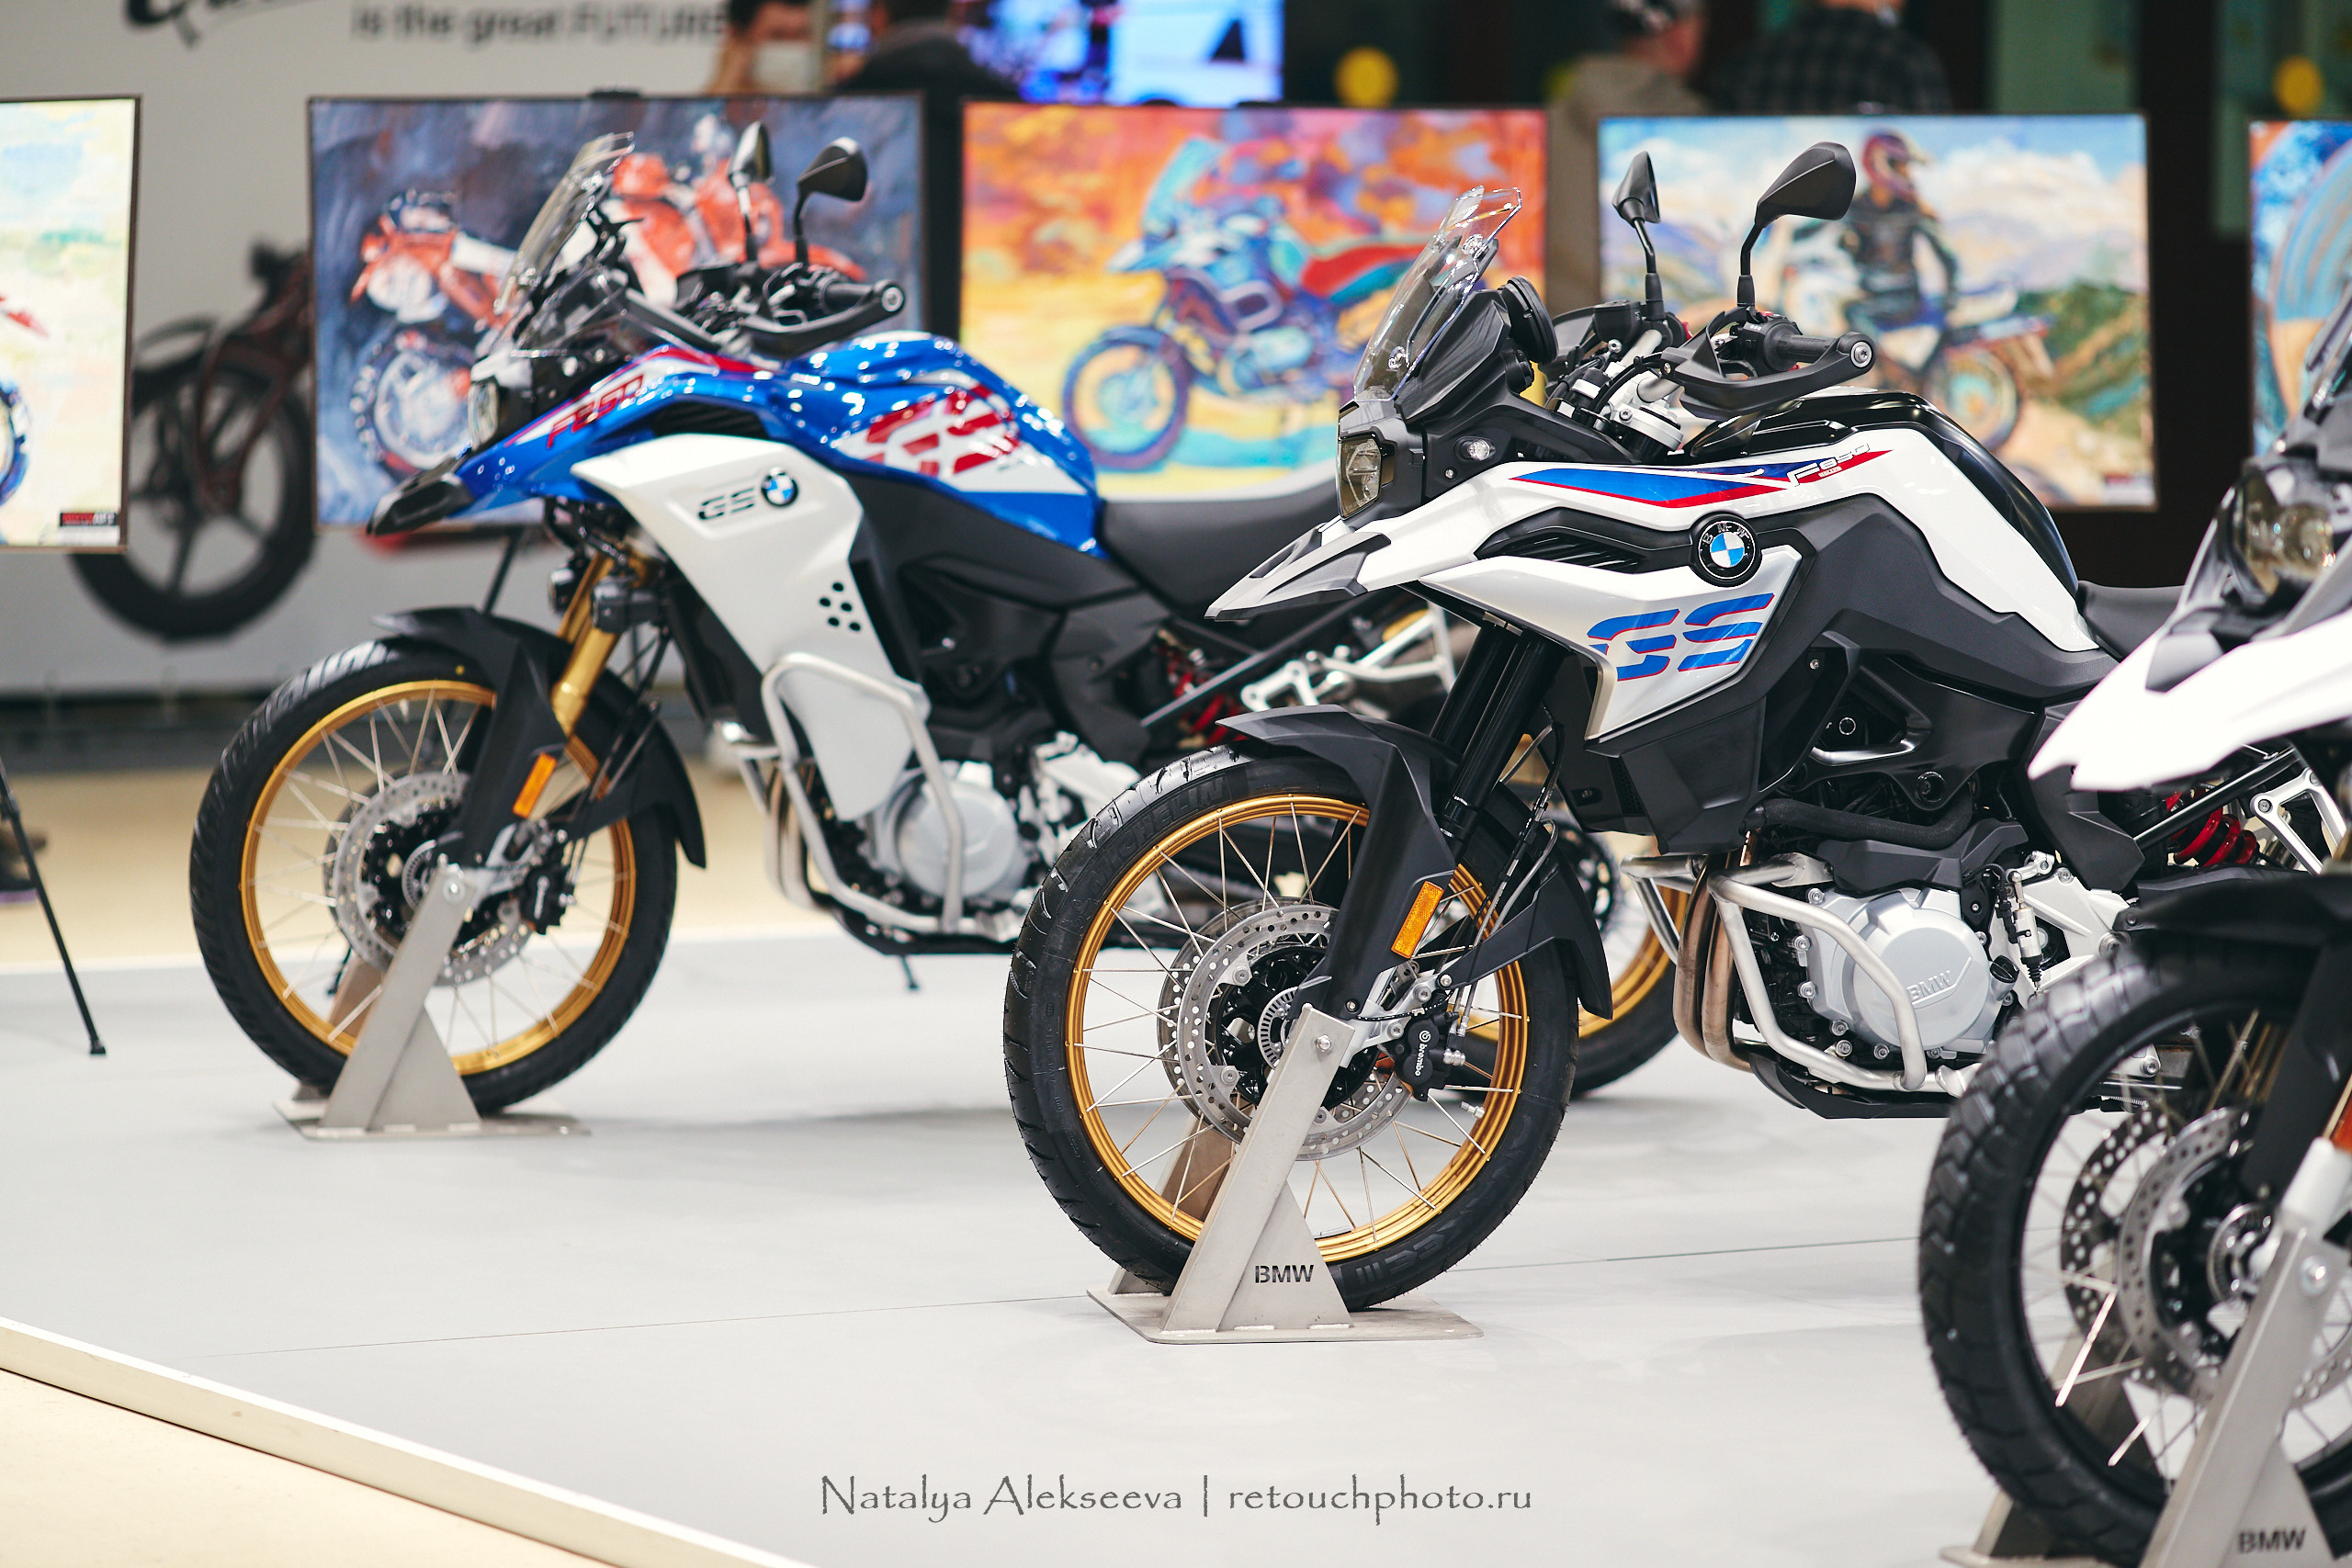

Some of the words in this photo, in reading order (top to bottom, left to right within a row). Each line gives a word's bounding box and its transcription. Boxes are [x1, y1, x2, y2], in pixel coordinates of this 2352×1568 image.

[352, 5, 385, 37] is
[393, 5, 452, 37] the
[466, 10, 556, 47] great
[1785, 442, 1871, 488] F850
[698, 487, 755, 520] GS
[1702, 522, 1750, 545] BMW
[1588, 592, 1775, 682] GS
[1906, 970, 1951, 1002] BMW
[1415, 1043, 1428, 1077] brembo
[1254, 1264, 1315, 1283] BMW
[2238, 1527, 2306, 1553] BMW
